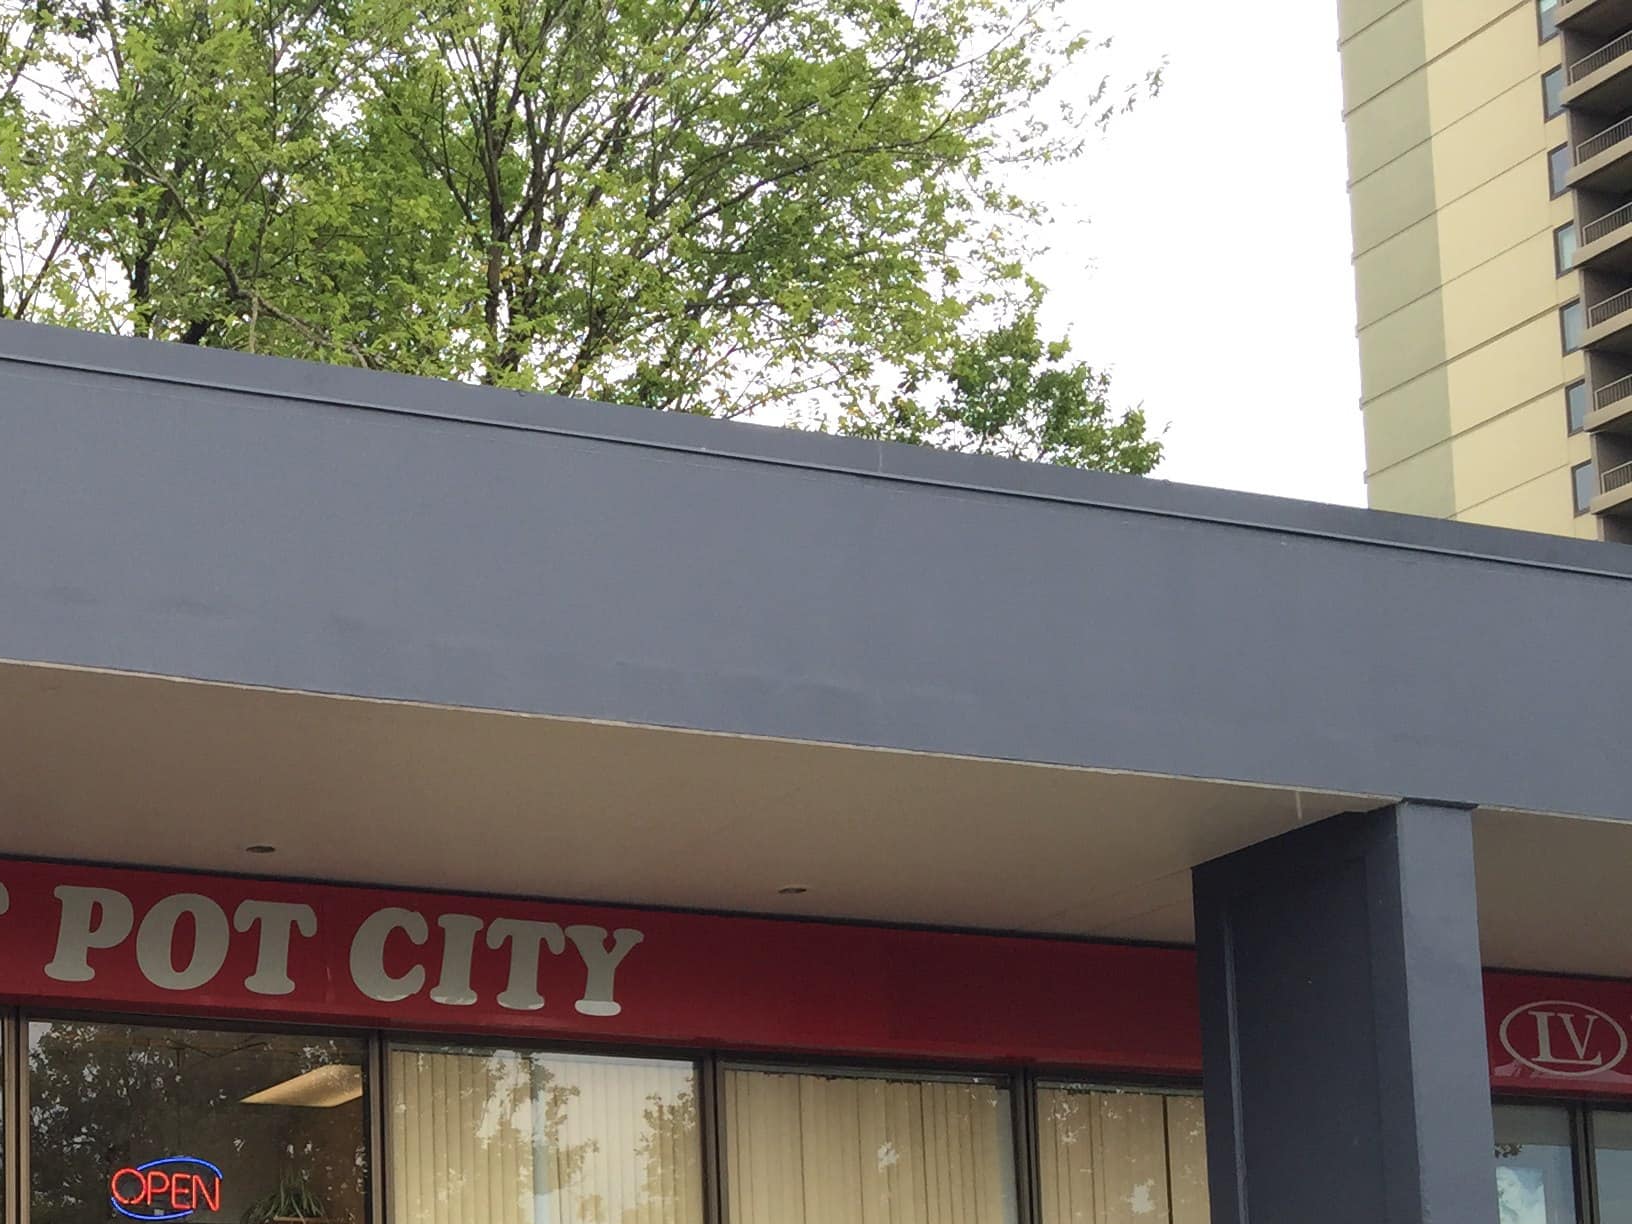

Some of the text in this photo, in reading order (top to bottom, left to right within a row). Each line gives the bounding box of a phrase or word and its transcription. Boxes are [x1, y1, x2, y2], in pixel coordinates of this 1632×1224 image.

[43, 884, 317, 995] POT
[349, 906, 645, 1016] CITY
[111, 1167, 220, 1212] OPEN
